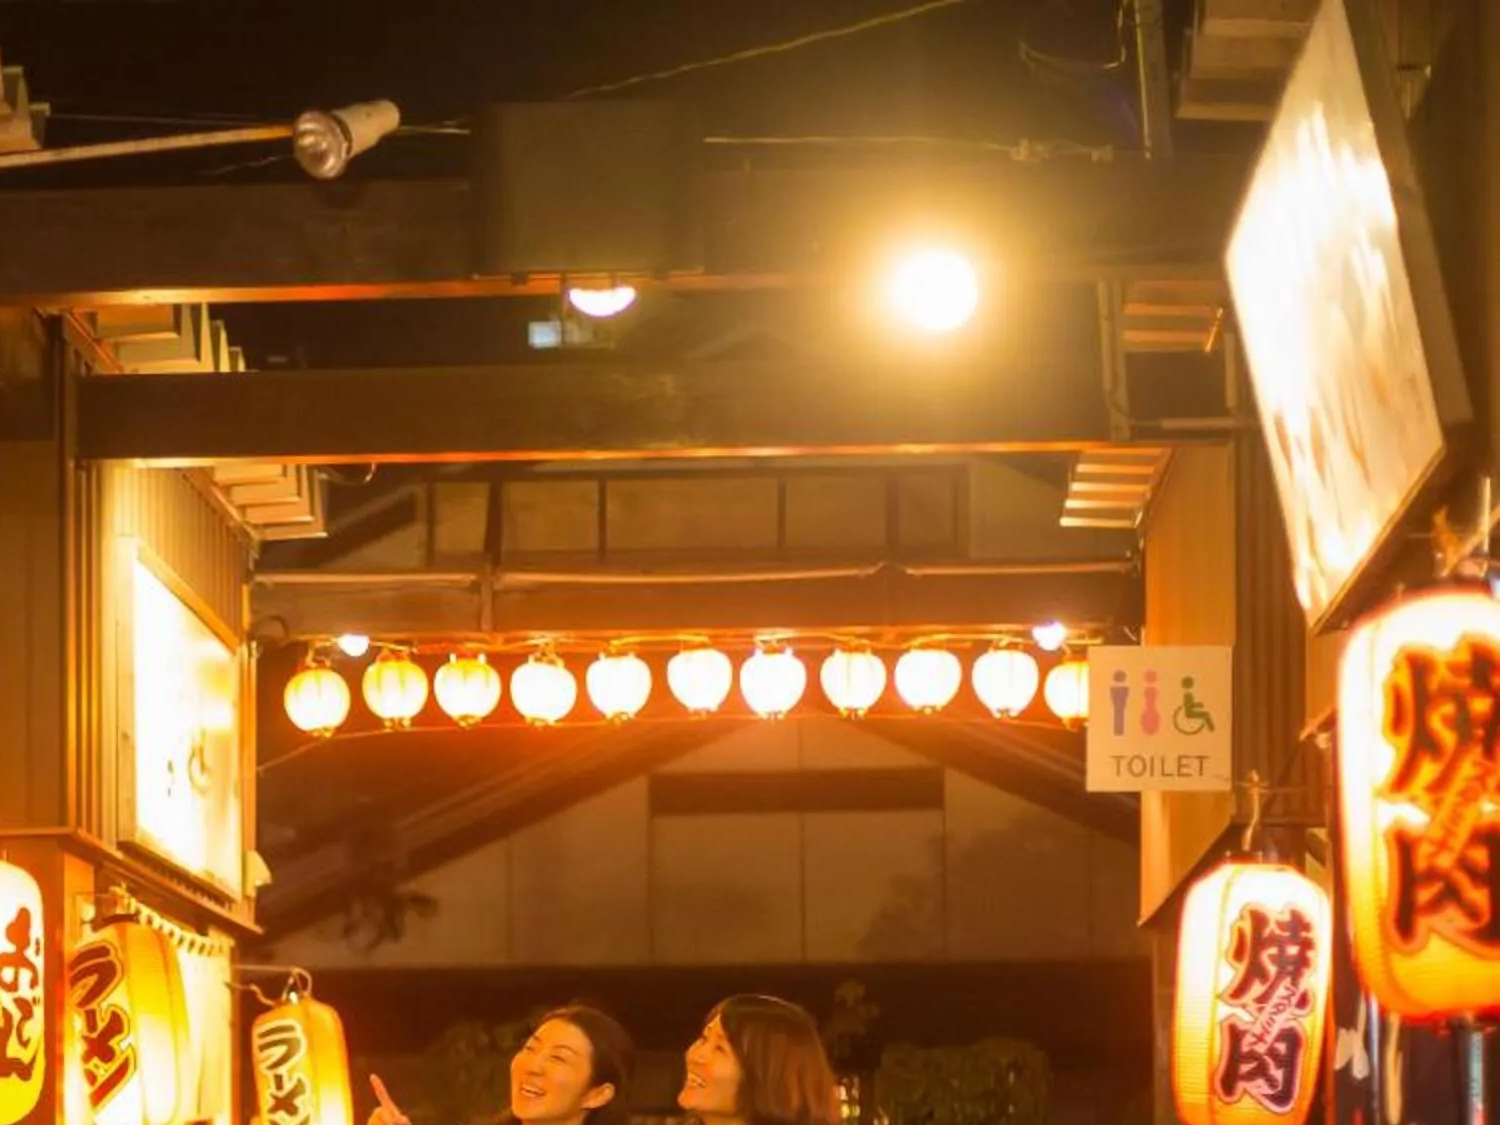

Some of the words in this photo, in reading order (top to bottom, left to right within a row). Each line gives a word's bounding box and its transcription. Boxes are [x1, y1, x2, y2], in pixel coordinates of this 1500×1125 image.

[1111, 755, 1211, 777] TOILET
[69, 944, 133, 1108] ラーメン
[1221, 907, 1316, 1109] 焼肉
